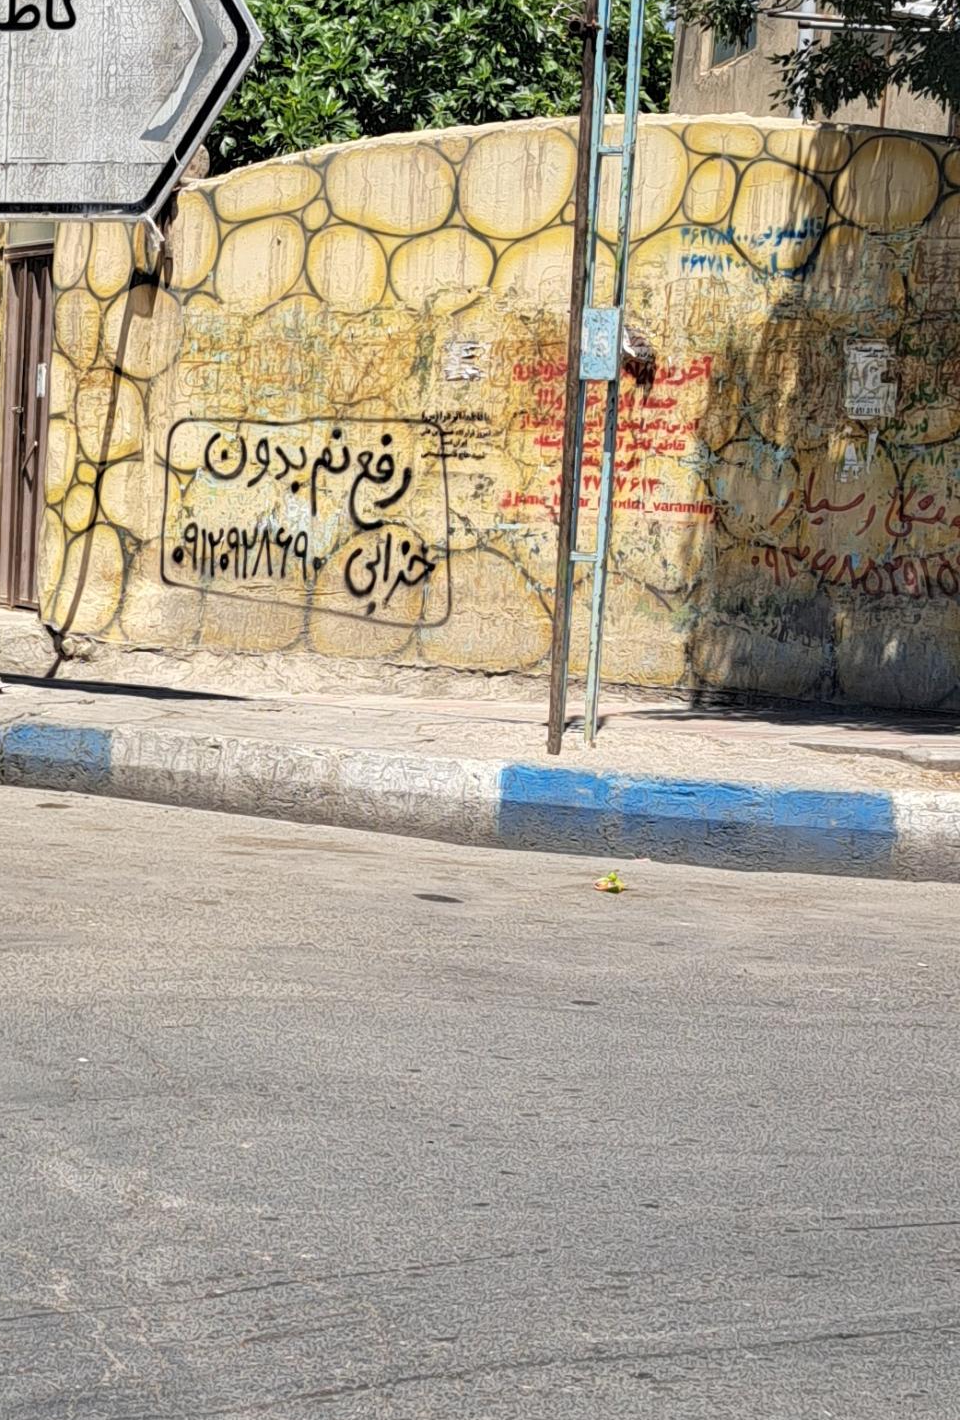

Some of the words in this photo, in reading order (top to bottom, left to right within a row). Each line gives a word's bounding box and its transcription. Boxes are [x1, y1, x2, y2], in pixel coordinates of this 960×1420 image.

[204, 432, 308, 494] بدون
[311, 429, 351, 517] نم
[349, 434, 412, 531] رفع
[344, 533, 436, 616] خرابی
